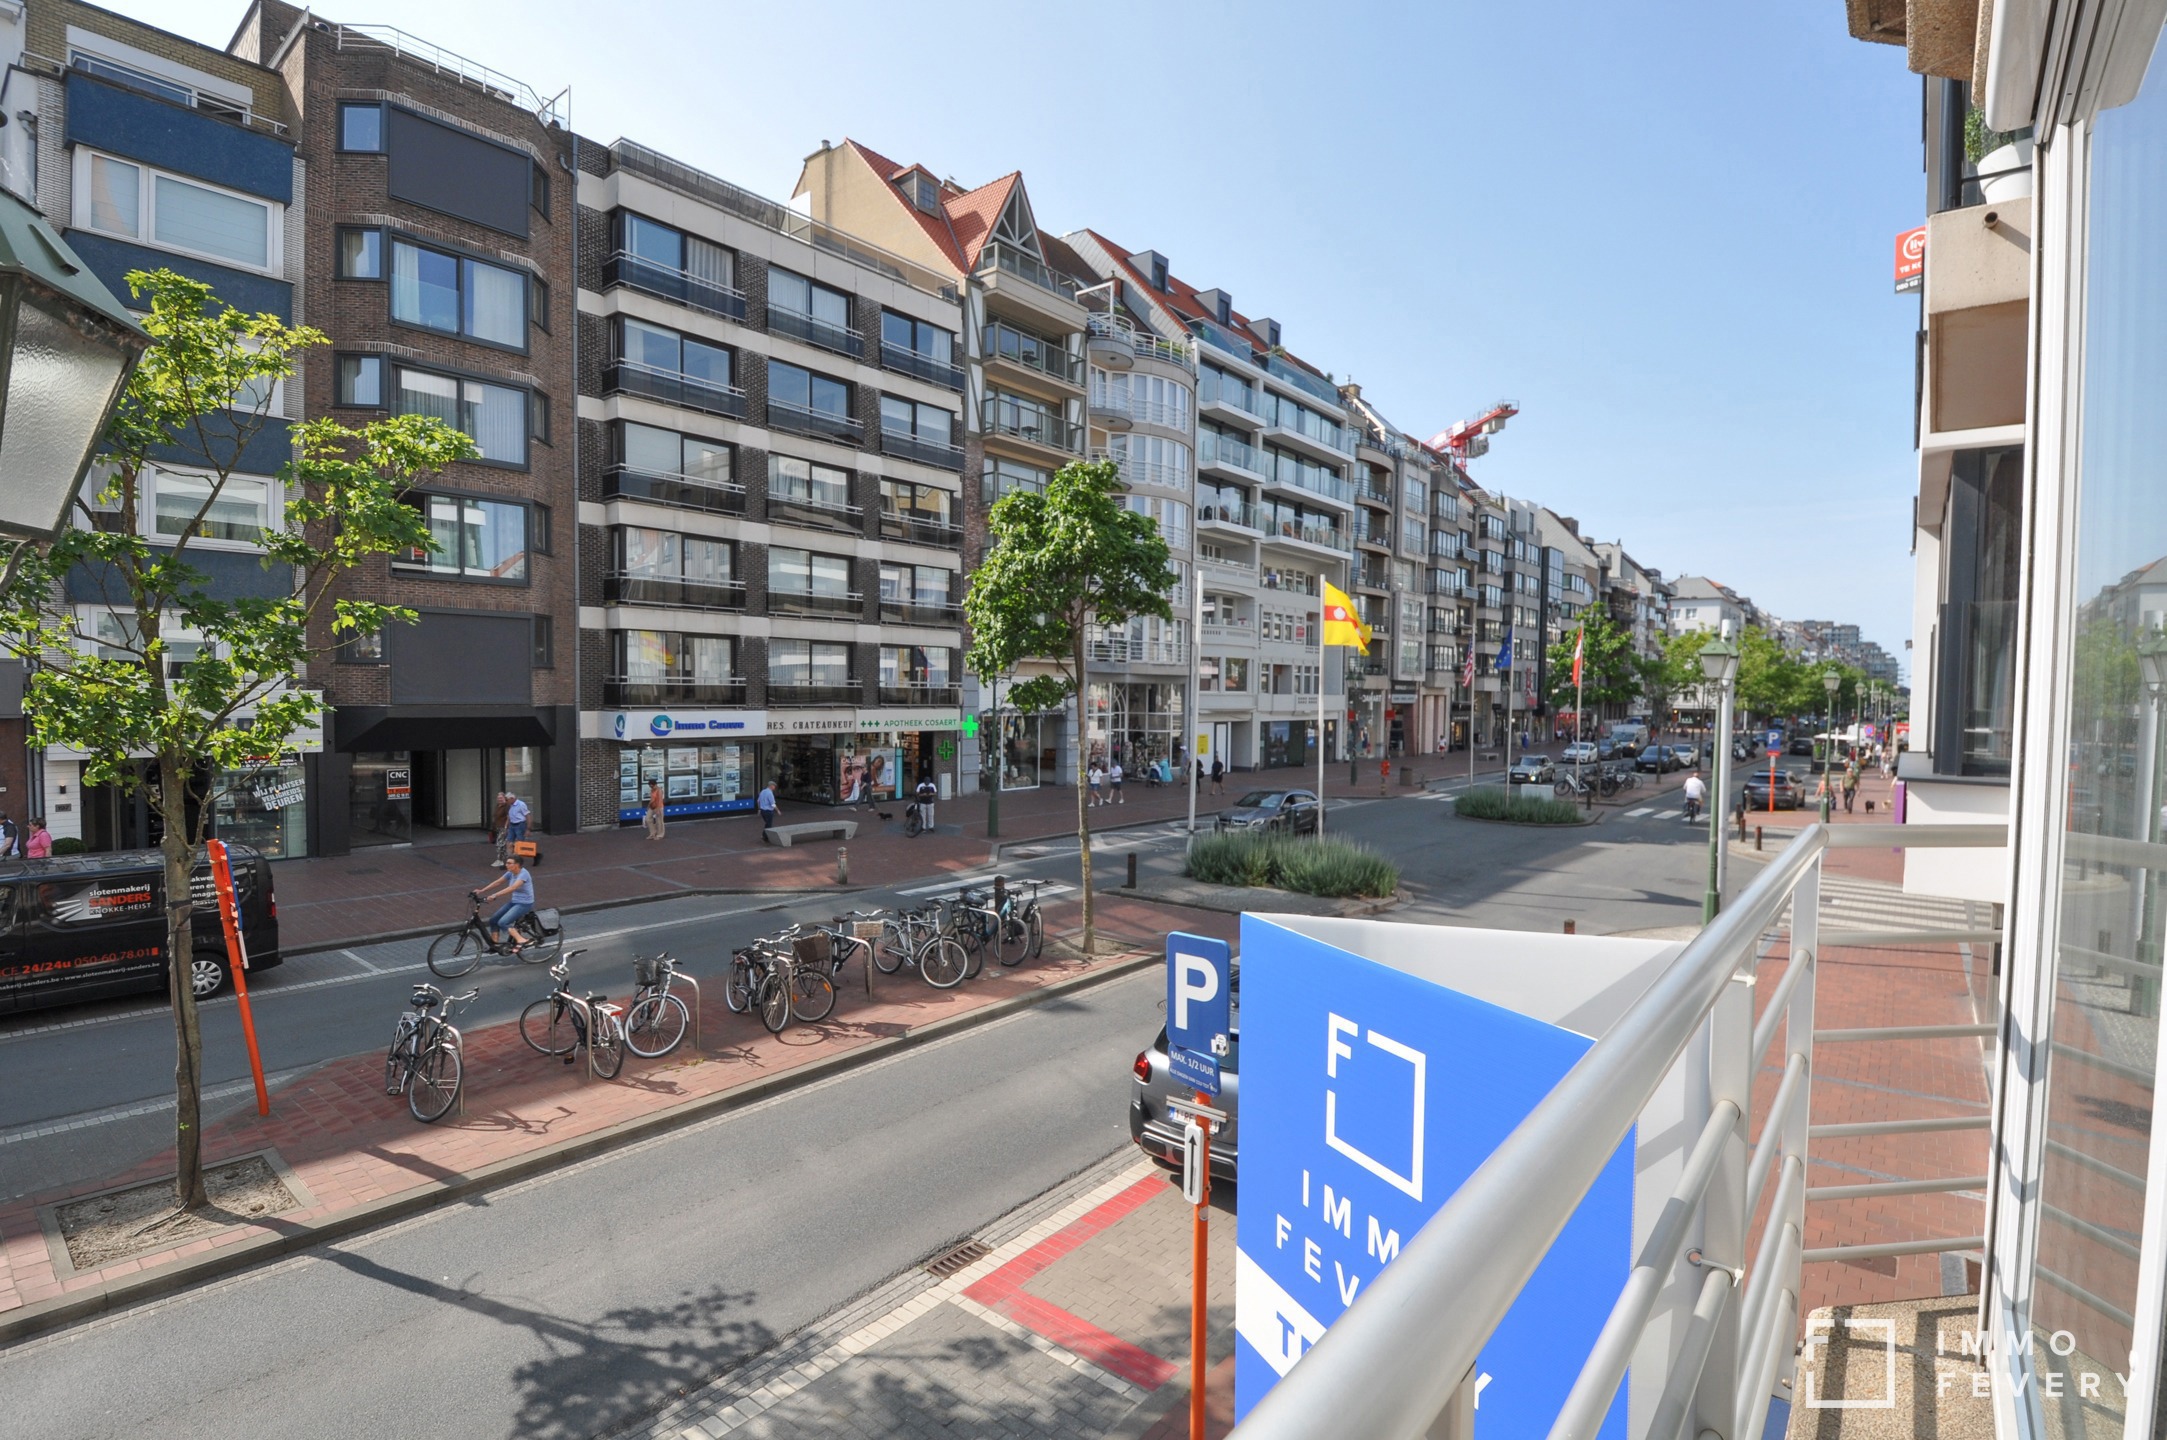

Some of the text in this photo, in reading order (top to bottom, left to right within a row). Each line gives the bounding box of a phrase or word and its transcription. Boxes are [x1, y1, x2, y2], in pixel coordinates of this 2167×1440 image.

[674, 720, 706, 730] Immo
[792, 720, 854, 730] CHATEAUNEUF
[883, 718, 957, 727] APOTHEEK COSAERT
[1768, 731, 1779, 745] P
[389, 771, 408, 779] CNC
[252, 778, 306, 798] WIJ PLAATSEN
[261, 787, 302, 802] VEILIGHEIDS
[264, 792, 304, 811] DEUREN
[88, 883, 151, 897] slotenmakerij
[88, 892, 152, 908] SANDERS
[89, 902, 152, 915] KNOKKE-HEIST
[22, 960, 72, 975] 24/24u
[64, 962, 160, 981] www.slotenmakerij-sanders.be
[1175, 952, 1219, 1030] P
[1170, 1051, 1215, 1077] MAX. 1/2 UUR
[1302, 1169, 1400, 1265] IMM
